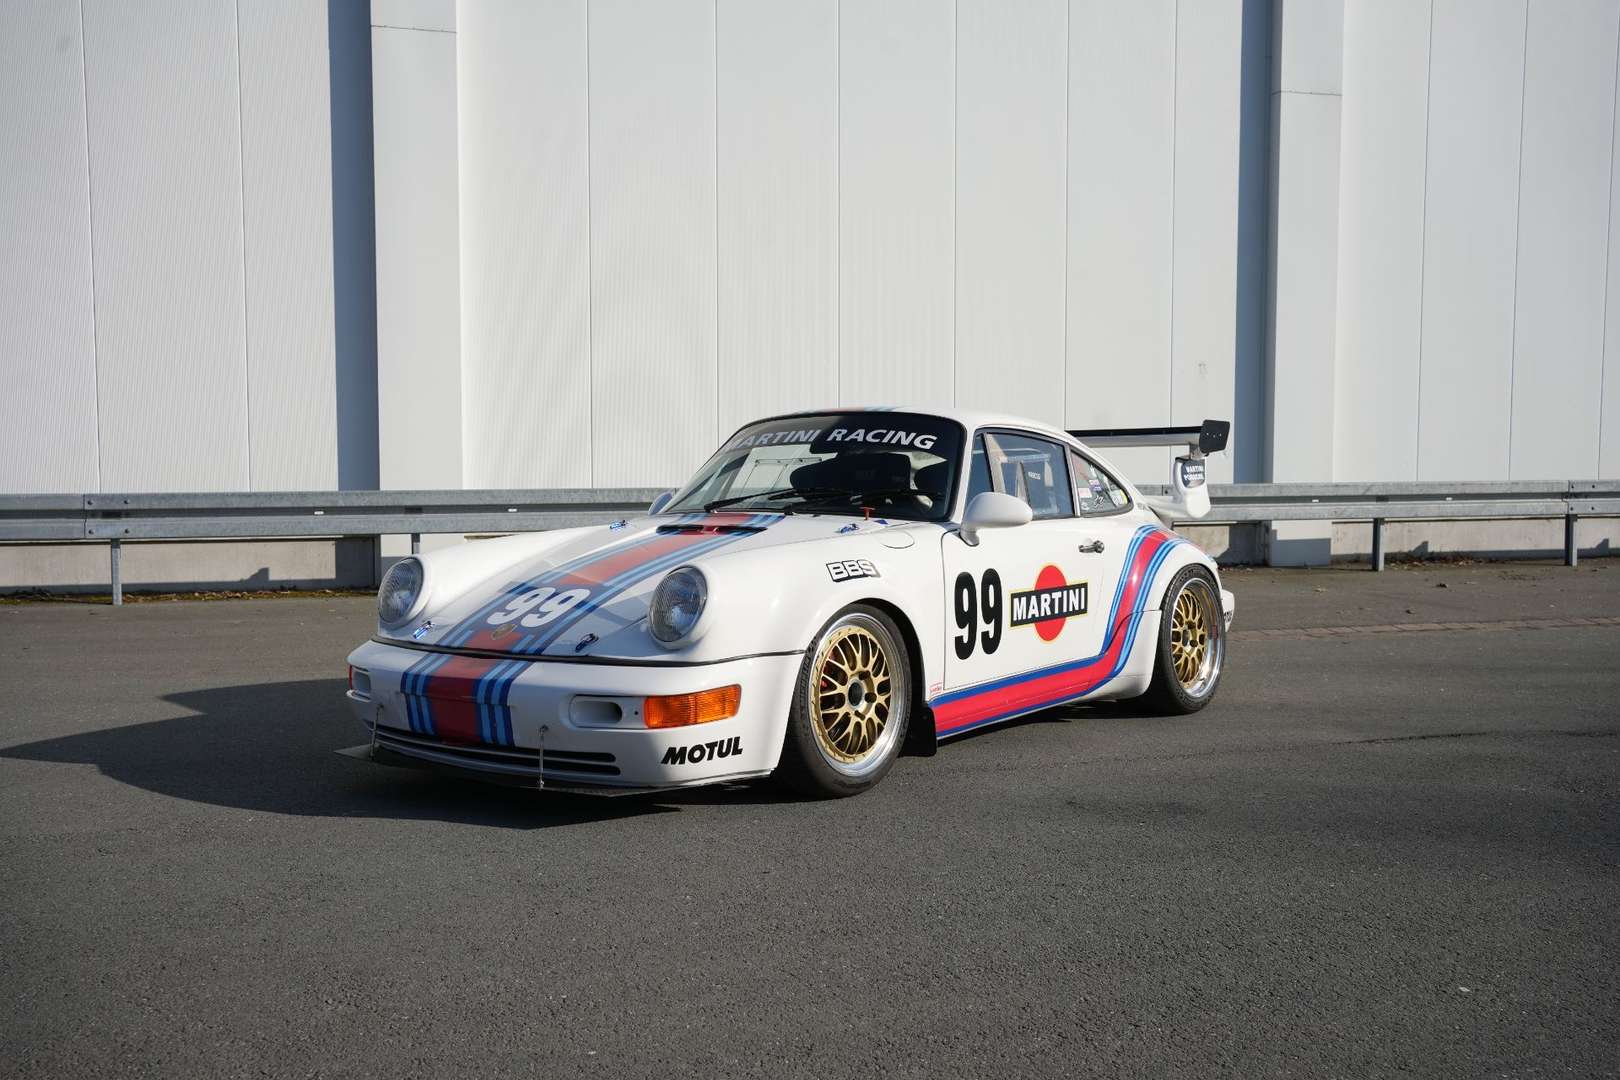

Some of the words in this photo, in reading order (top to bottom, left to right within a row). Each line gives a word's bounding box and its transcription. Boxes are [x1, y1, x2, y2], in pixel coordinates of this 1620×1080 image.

[827, 429, 937, 449] RACING
[826, 559, 880, 582] BBS
[486, 587, 591, 628] 99
[954, 568, 1003, 660] 99
[1013, 587, 1085, 621] MARTINI
[660, 736, 744, 765] MOTUL
